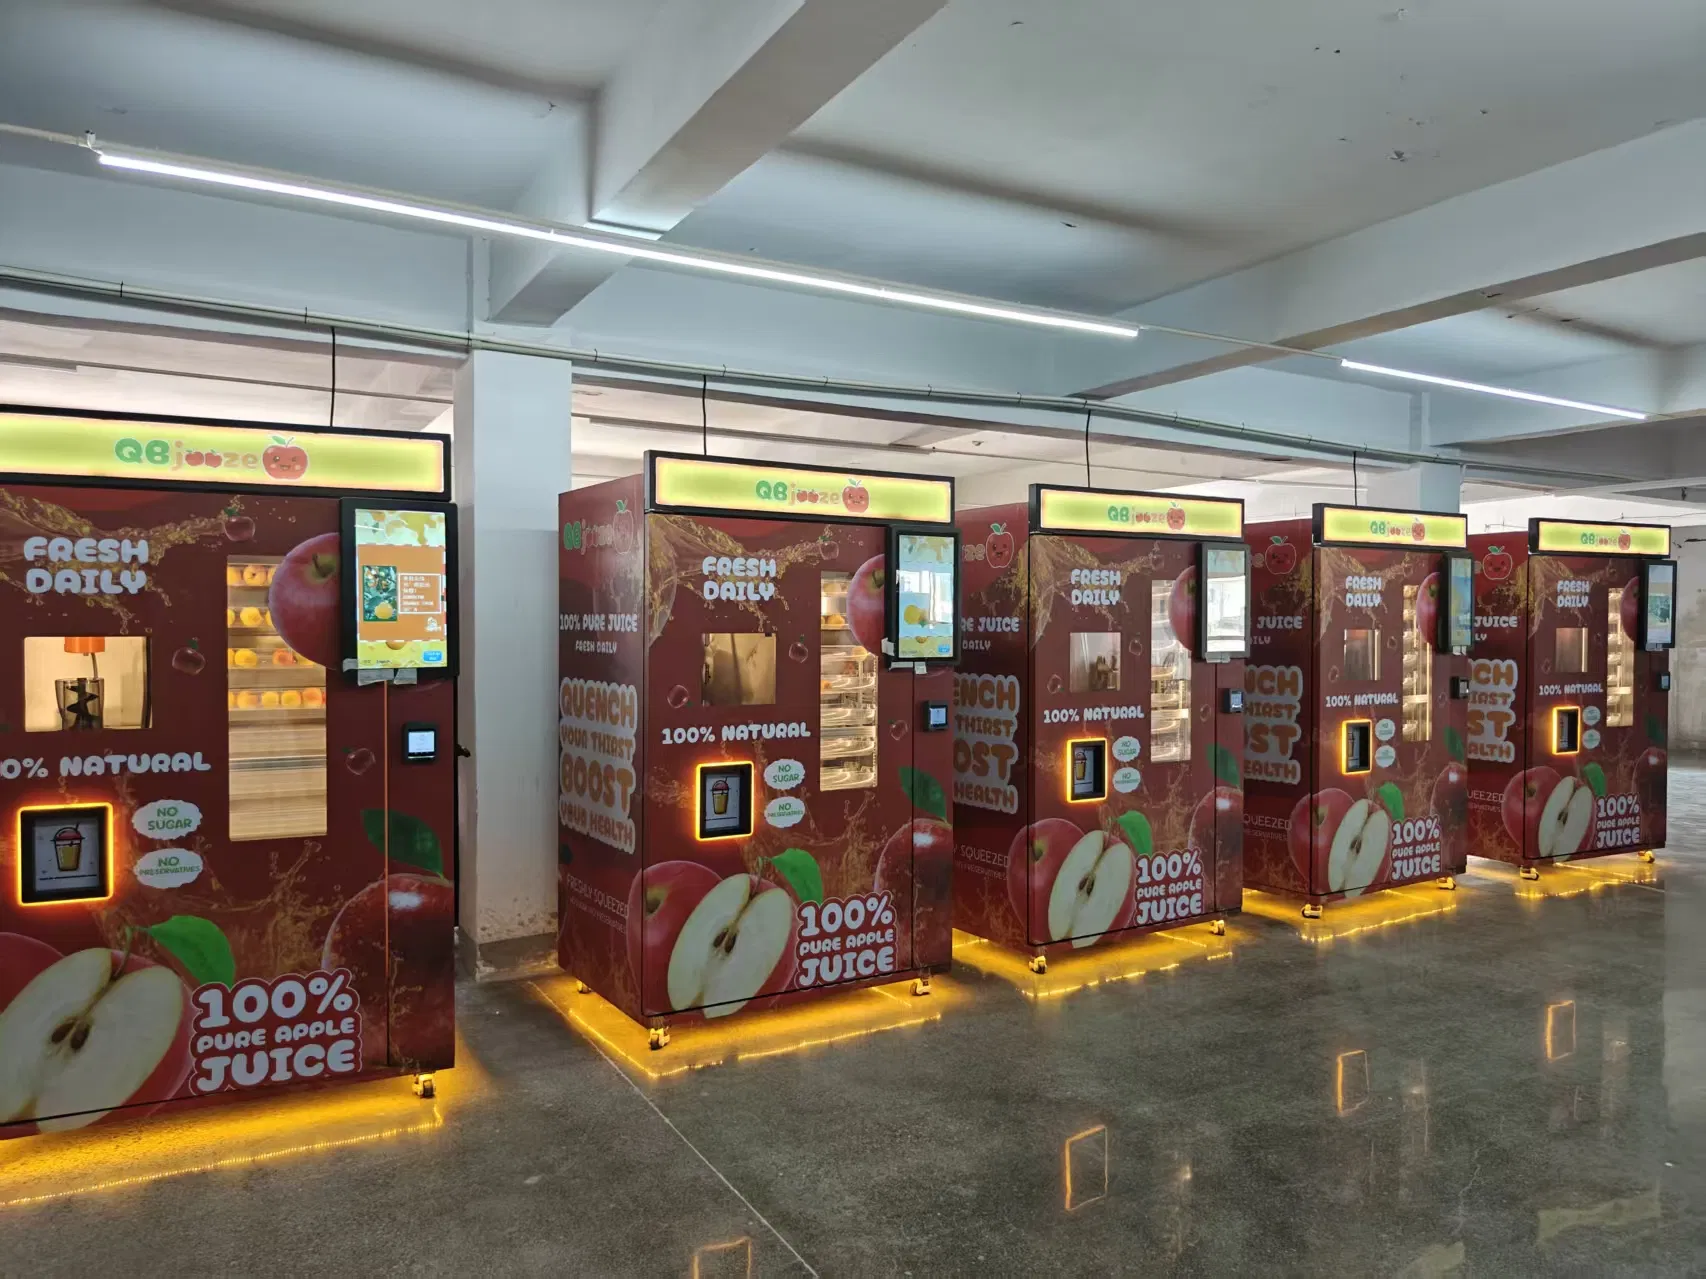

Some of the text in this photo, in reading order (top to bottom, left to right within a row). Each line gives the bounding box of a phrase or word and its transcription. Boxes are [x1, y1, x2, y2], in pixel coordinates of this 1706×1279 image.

[24, 536, 149, 564] FRESH
[702, 556, 777, 578] FRESH
[1070, 568, 1121, 586] FRESH
[26, 567, 147, 595] DAILY
[703, 581, 775, 601] DAILY
[1346, 576, 1382, 590] FRESH
[1557, 580, 1590, 593] FRESH
[1071, 588, 1120, 606] DAILY
[1346, 592, 1382, 607] DAILY
[1557, 596, 1588, 607] DAILY
[560, 613, 638, 633] 100% PURE JUICE
[978, 616, 1020, 632] JUICE
[1257, 616, 1303, 629] JUICE
[1474, 616, 1518, 628] JUICE
[575, 640, 617, 654] FRESH DAILY
[962, 640, 991, 650] DAILY
[1325, 692, 1399, 707] 100% NATURAL
[1539, 683, 1604, 696] 100% NATURAL
[561, 683, 635, 728] QUENCH
[1043, 706, 1145, 723] 100% NATURAL
[662, 722, 811, 745] 100% NATURAL
[955, 714, 1013, 737] THIRST
[561, 724, 632, 761] YOUR THIRST
[1468, 742, 1511, 759] ALTH
[60, 751, 211, 777] NATURAL
[778, 764, 791, 772] NO
[953, 738, 1015, 780] OST
[773, 774, 799, 783] SUGAR
[1244, 760, 1297, 779] EALTH
[561, 752, 634, 813] BOOST
[954, 781, 1015, 808] HEALTH
[1467, 789, 1505, 803] UEEZED
[157, 806, 178, 817] NO
[779, 803, 791, 811] NO
[1597, 796, 1640, 818] 100%
[147, 818, 192, 831] SUGAR
[561, 800, 633, 847] YOUR HEALTH
[1243, 813, 1292, 830] QUEEZED
[1393, 818, 1440, 845] 100%
[1597, 828, 1640, 848] JUICE
[960, 845, 1010, 868] SQUEEZED
[1392, 843, 1440, 858] PURE APPLE
[158, 856, 179, 867] NO
[1137, 851, 1200, 884] 100%
[1392, 855, 1440, 880] JUICE
[1137, 879, 1201, 899] PURE APPLE
[594, 889, 628, 919] SQUEEZED
[1137, 893, 1201, 925] JUICE
[800, 896, 893, 936] 100%
[800, 929, 894, 956] PURE APPLE
[800, 946, 894, 988] JUICE
[198, 975, 353, 1029] 100%
[196, 1016, 355, 1054] PURE APPLE
[197, 1040, 355, 1092] JUICE
